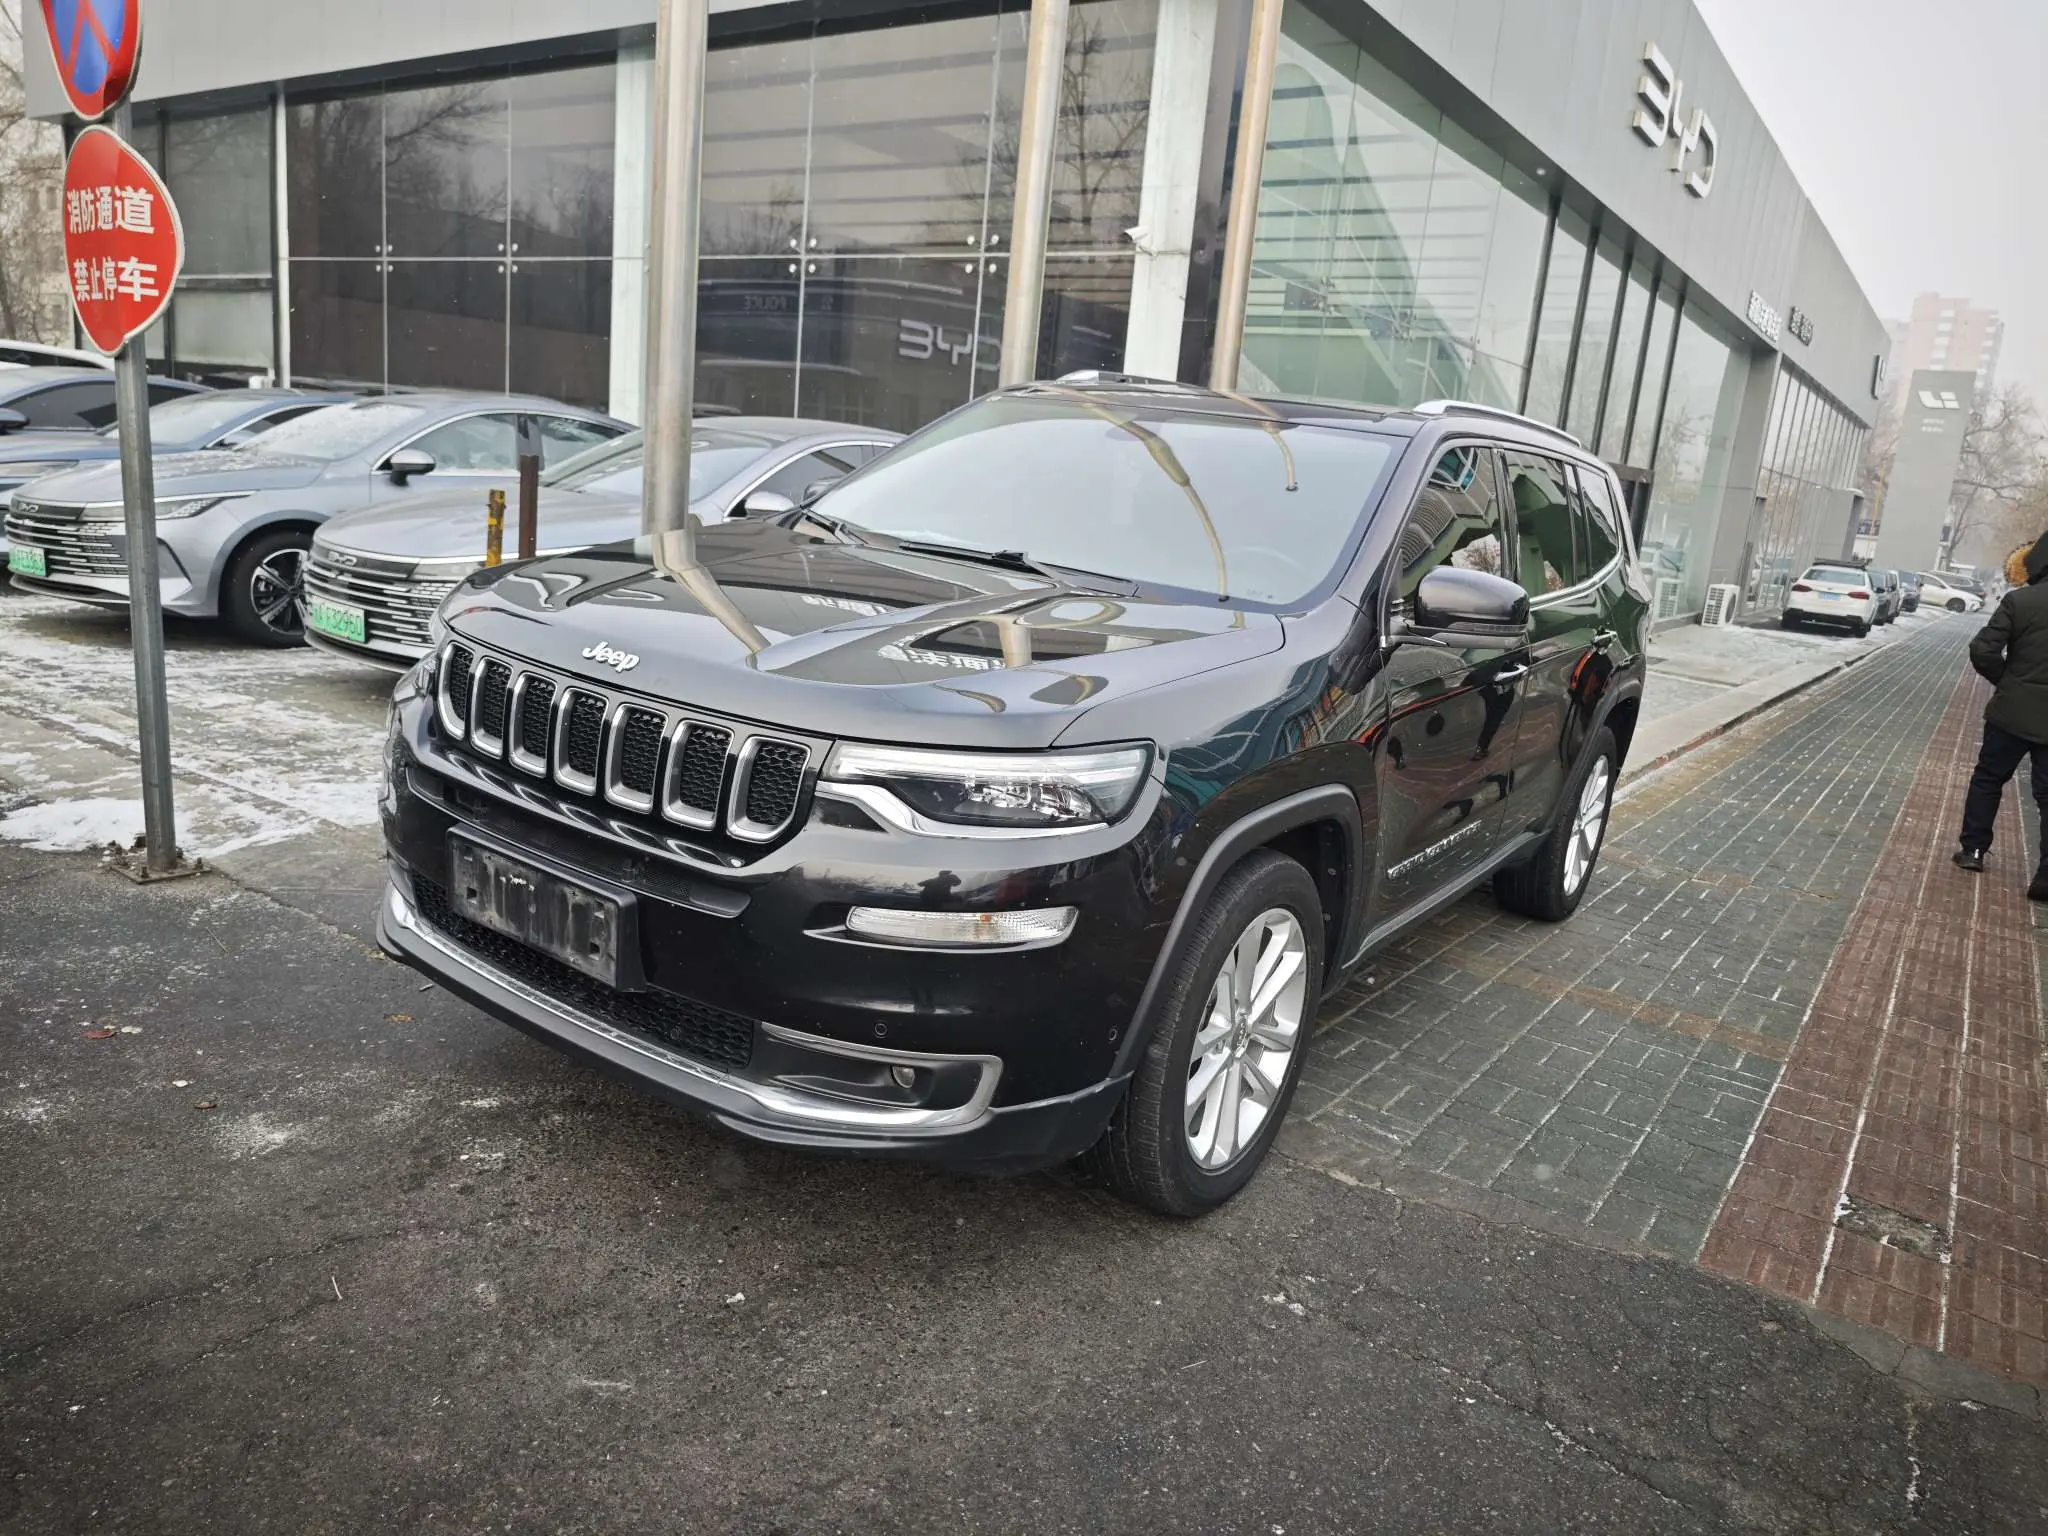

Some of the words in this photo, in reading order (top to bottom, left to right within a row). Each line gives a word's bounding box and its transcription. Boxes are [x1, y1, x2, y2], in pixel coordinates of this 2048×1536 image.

[1632, 40, 1718, 199] BYD
[67, 185, 155, 234] 消防通道
[73, 256, 160, 302] 禁止停车
[582, 641, 640, 673] Jeep
